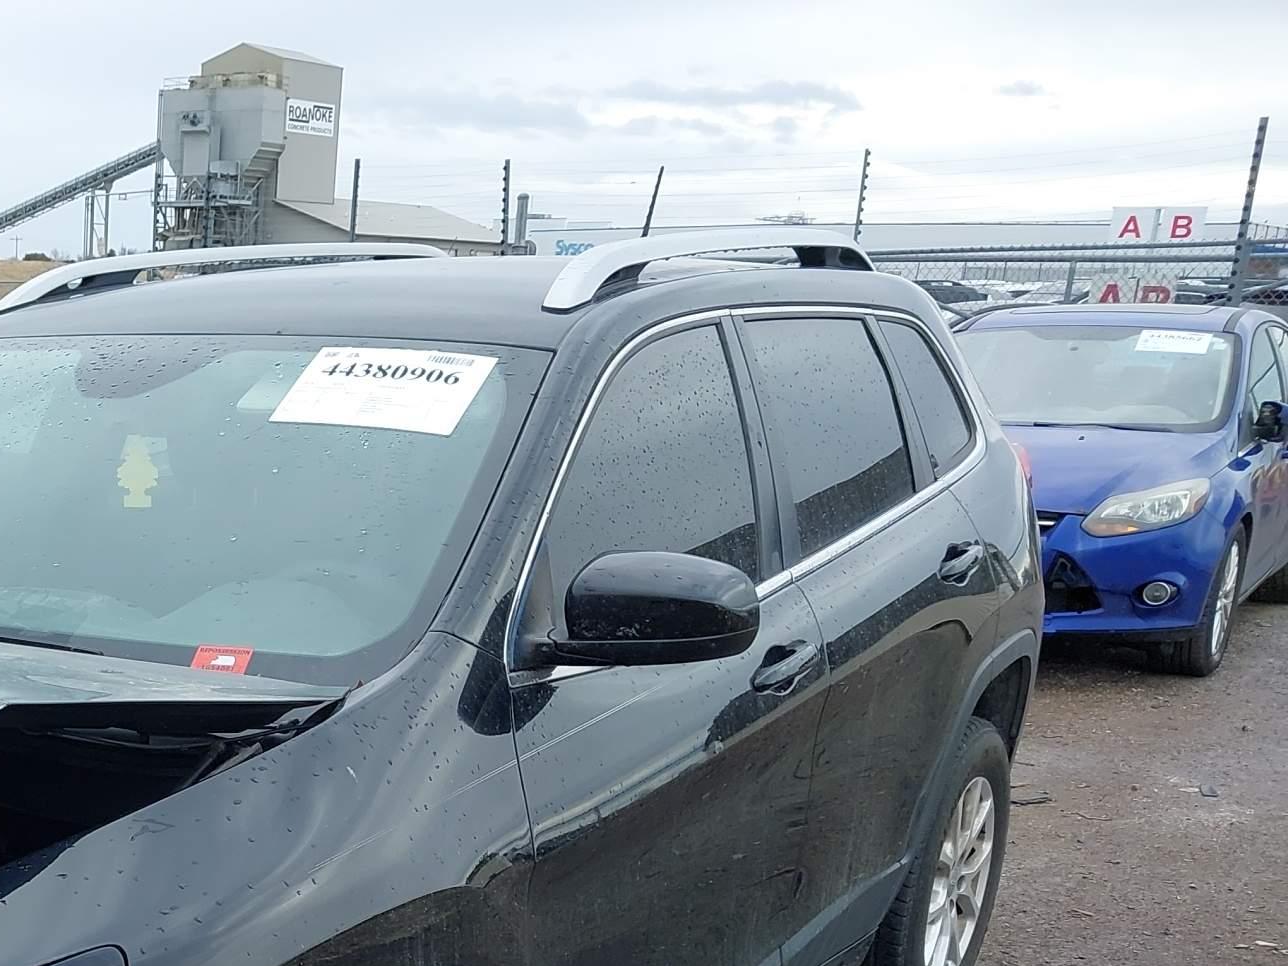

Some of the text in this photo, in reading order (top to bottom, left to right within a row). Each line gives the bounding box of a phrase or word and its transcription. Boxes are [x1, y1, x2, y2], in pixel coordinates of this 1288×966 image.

[288, 105, 333, 123] ROANOKE
[1118, 215, 1192, 238] A B
[321, 362, 464, 385] 44380906
